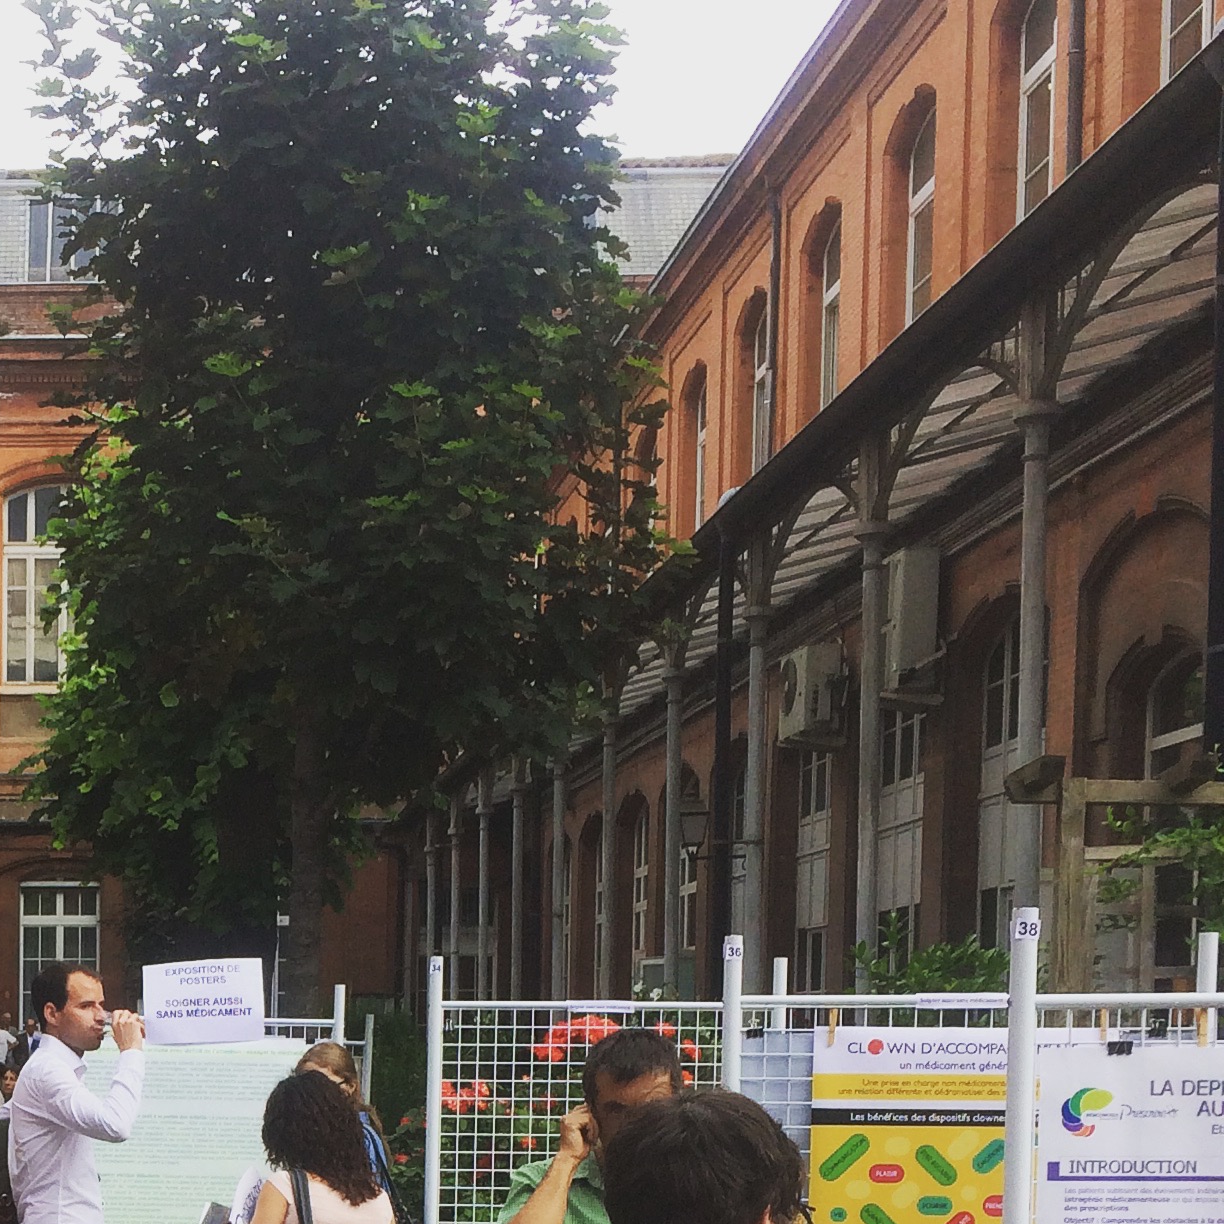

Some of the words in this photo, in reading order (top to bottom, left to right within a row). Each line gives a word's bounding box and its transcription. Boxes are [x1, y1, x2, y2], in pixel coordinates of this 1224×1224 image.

[1018, 921, 1038, 937] 38
[728, 947, 742, 957] 36
[165, 965, 224, 977] EXPOSITION
[227, 965, 241, 973] DE
[431, 963, 441, 973] 34
[180, 975, 227, 985] POSTERS
[165, 998, 210, 1008] SOIGNER
[213, 997, 243, 1006] AUSSI
[156, 1010, 184, 1019] SANS
[186, 1006, 252, 1018] MÉDICAMENT
[900, 1062, 911, 1070] un
[916, 1061, 976, 1070] médicament
[880, 1079, 899, 1088] prise
[913, 1079, 940, 1088] charge
[1150, 1080, 1174, 1096] LA
[850, 1112, 865, 1121] Les
[867, 1112, 909, 1122] bénéfices
[911, 1113, 926, 1122] des
[928, 1113, 970, 1124] dispositifs
[1069, 1160, 1198, 1174] INTRODUCTION
